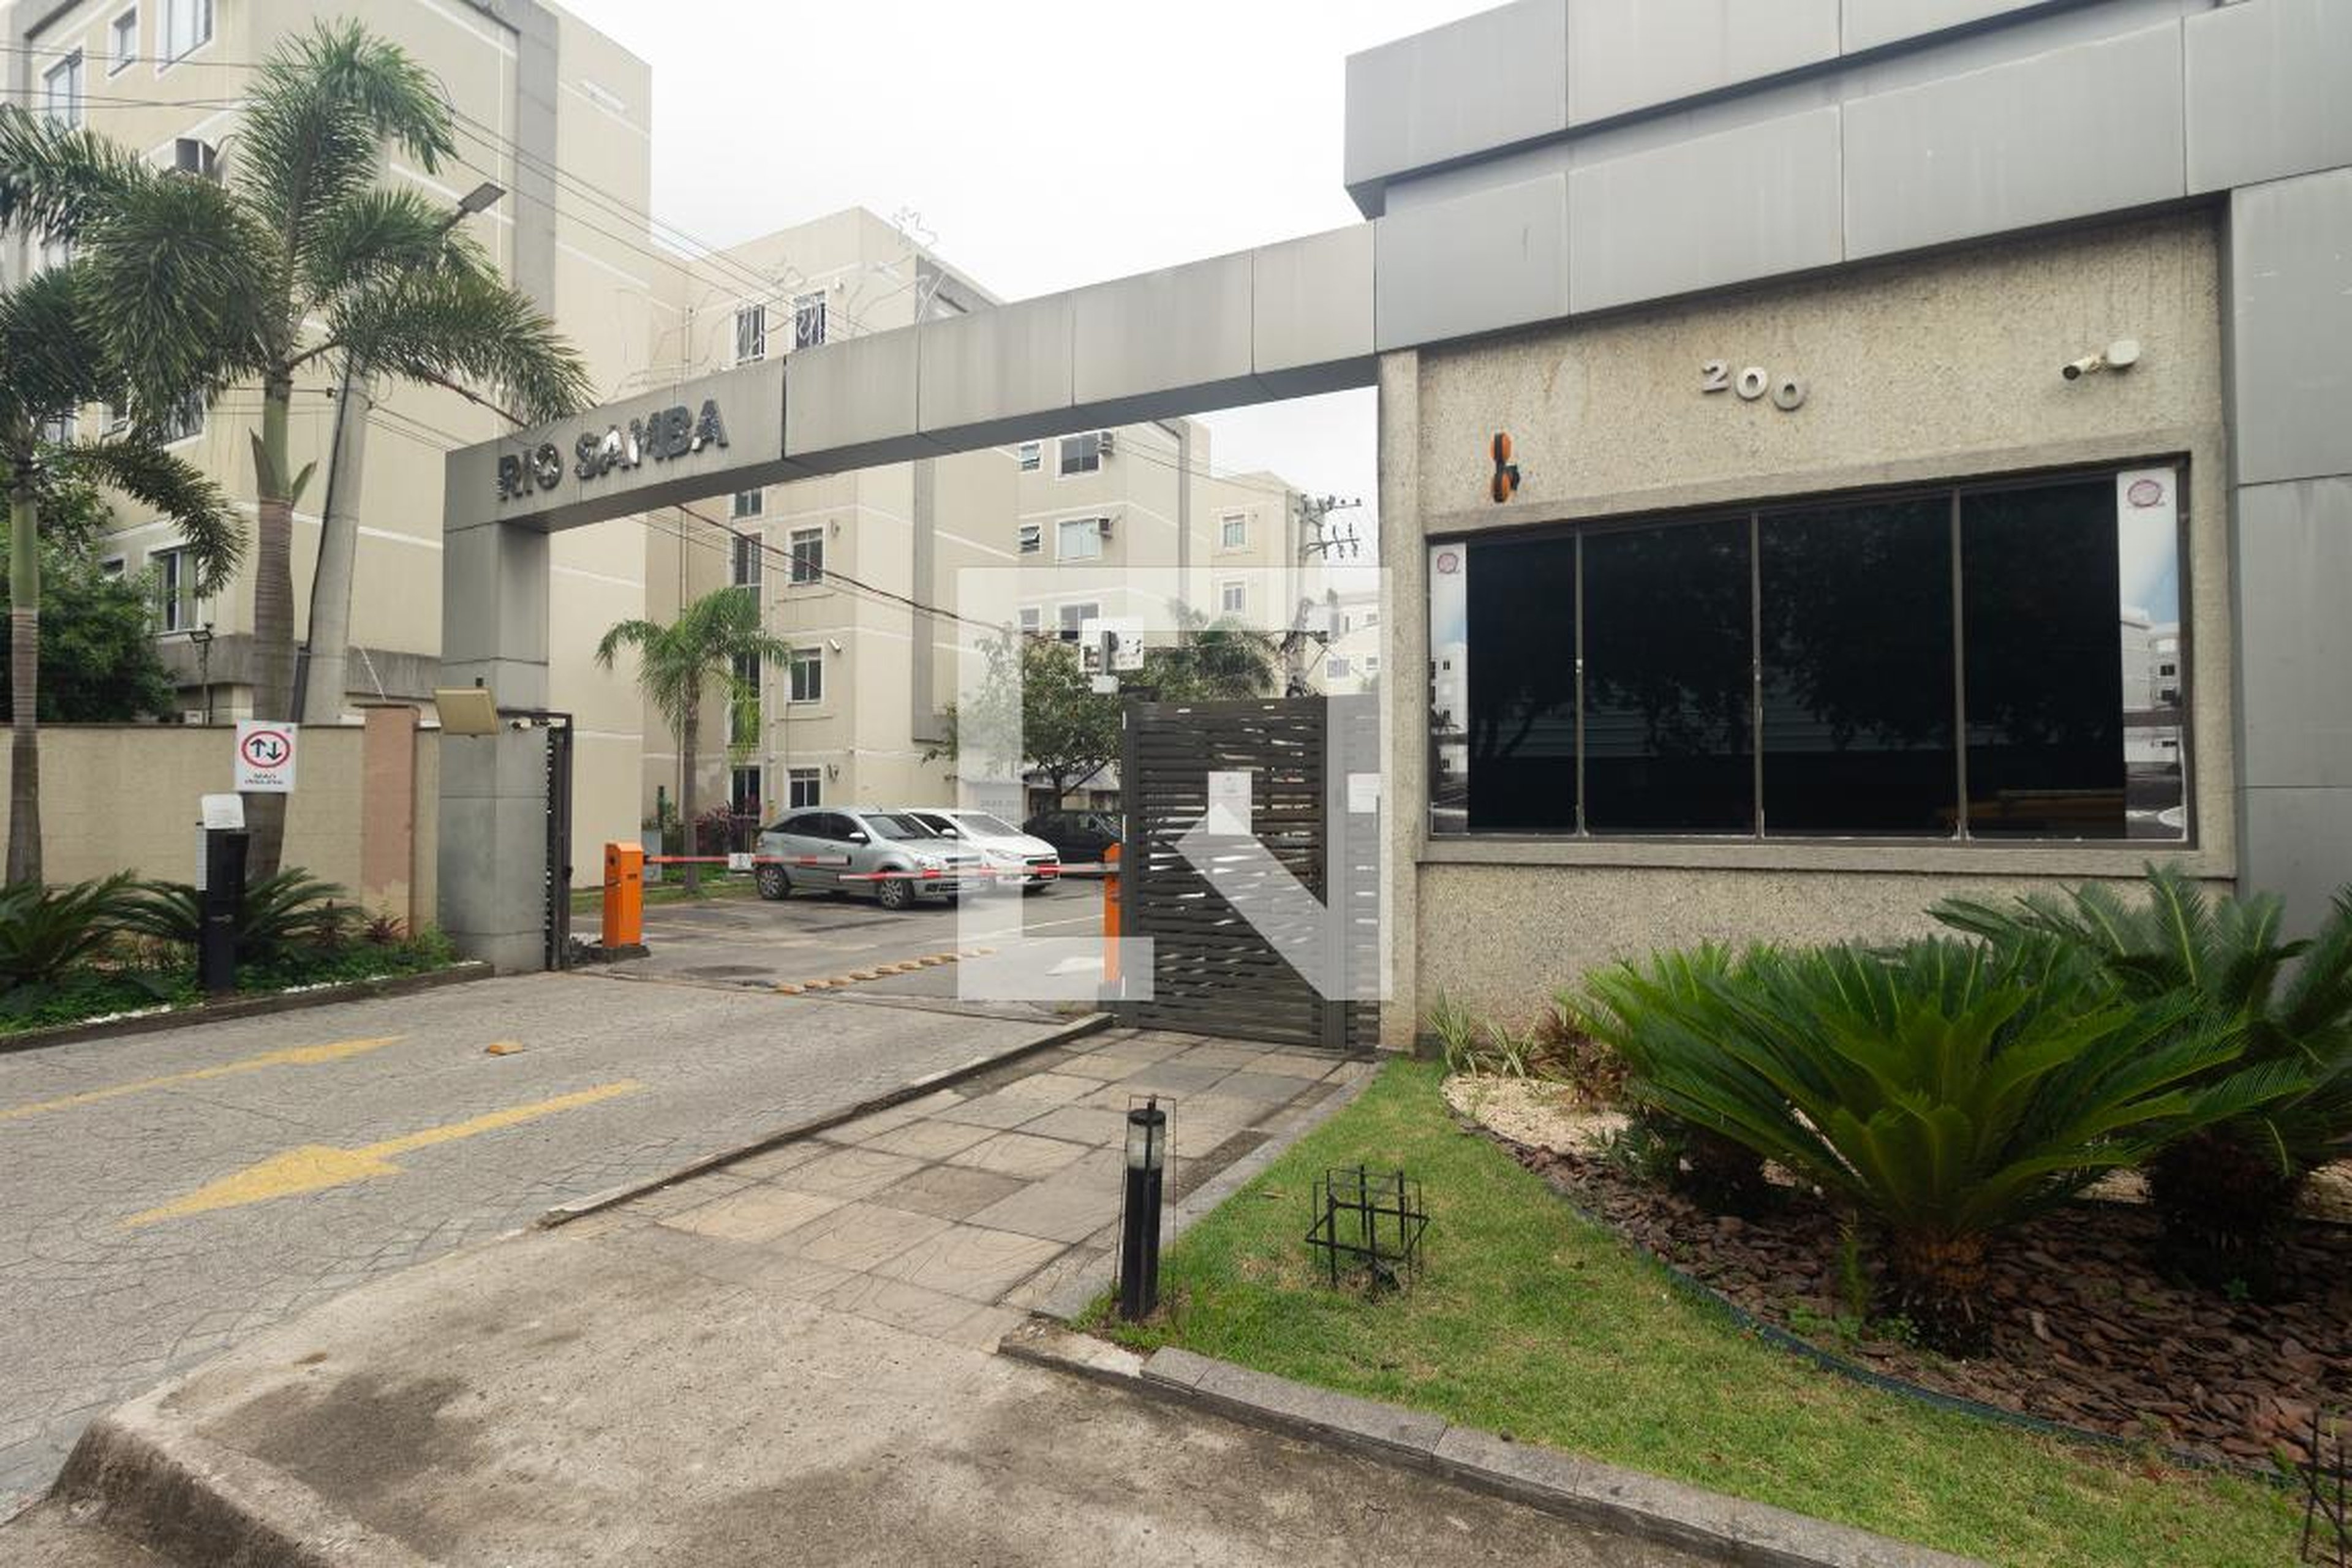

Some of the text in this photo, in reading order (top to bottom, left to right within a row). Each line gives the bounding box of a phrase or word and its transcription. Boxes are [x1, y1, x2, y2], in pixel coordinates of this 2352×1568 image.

[1701, 358, 1809, 412] 200
[497, 399, 729, 501] RIO SAMBA
